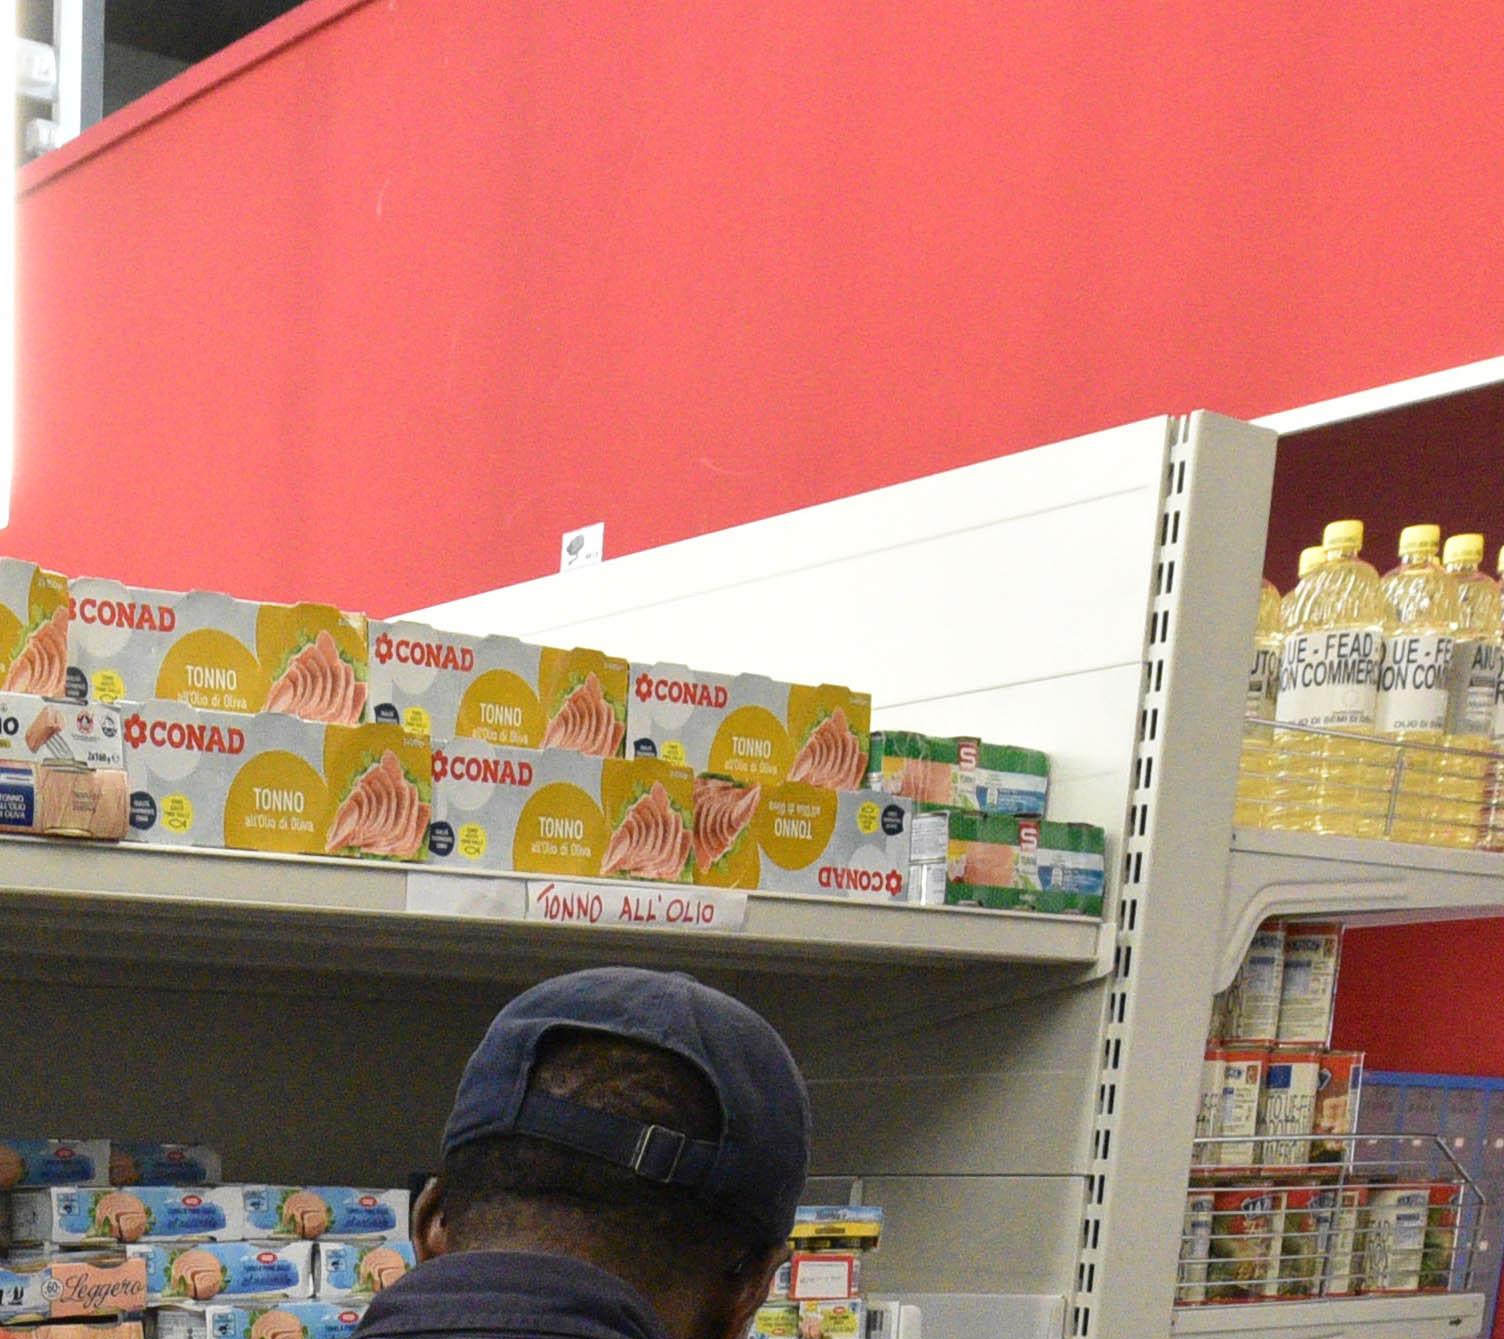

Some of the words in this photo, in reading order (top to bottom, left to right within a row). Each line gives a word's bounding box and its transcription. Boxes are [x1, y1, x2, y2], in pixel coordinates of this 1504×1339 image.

[80, 599, 175, 632] CONAD
[396, 640, 474, 671] CONAD
[1325, 633, 1372, 659] FEAD
[186, 665, 237, 689] TONNO
[654, 680, 728, 708] CONAD
[480, 703, 522, 726] TONNO
[149, 725, 245, 754] CONAD
[450, 755, 533, 787] CONAD
[254, 788, 305, 812] TONNO
[537, 884, 603, 922] TONNO
[61, 1273, 142, 1309] Leggero
